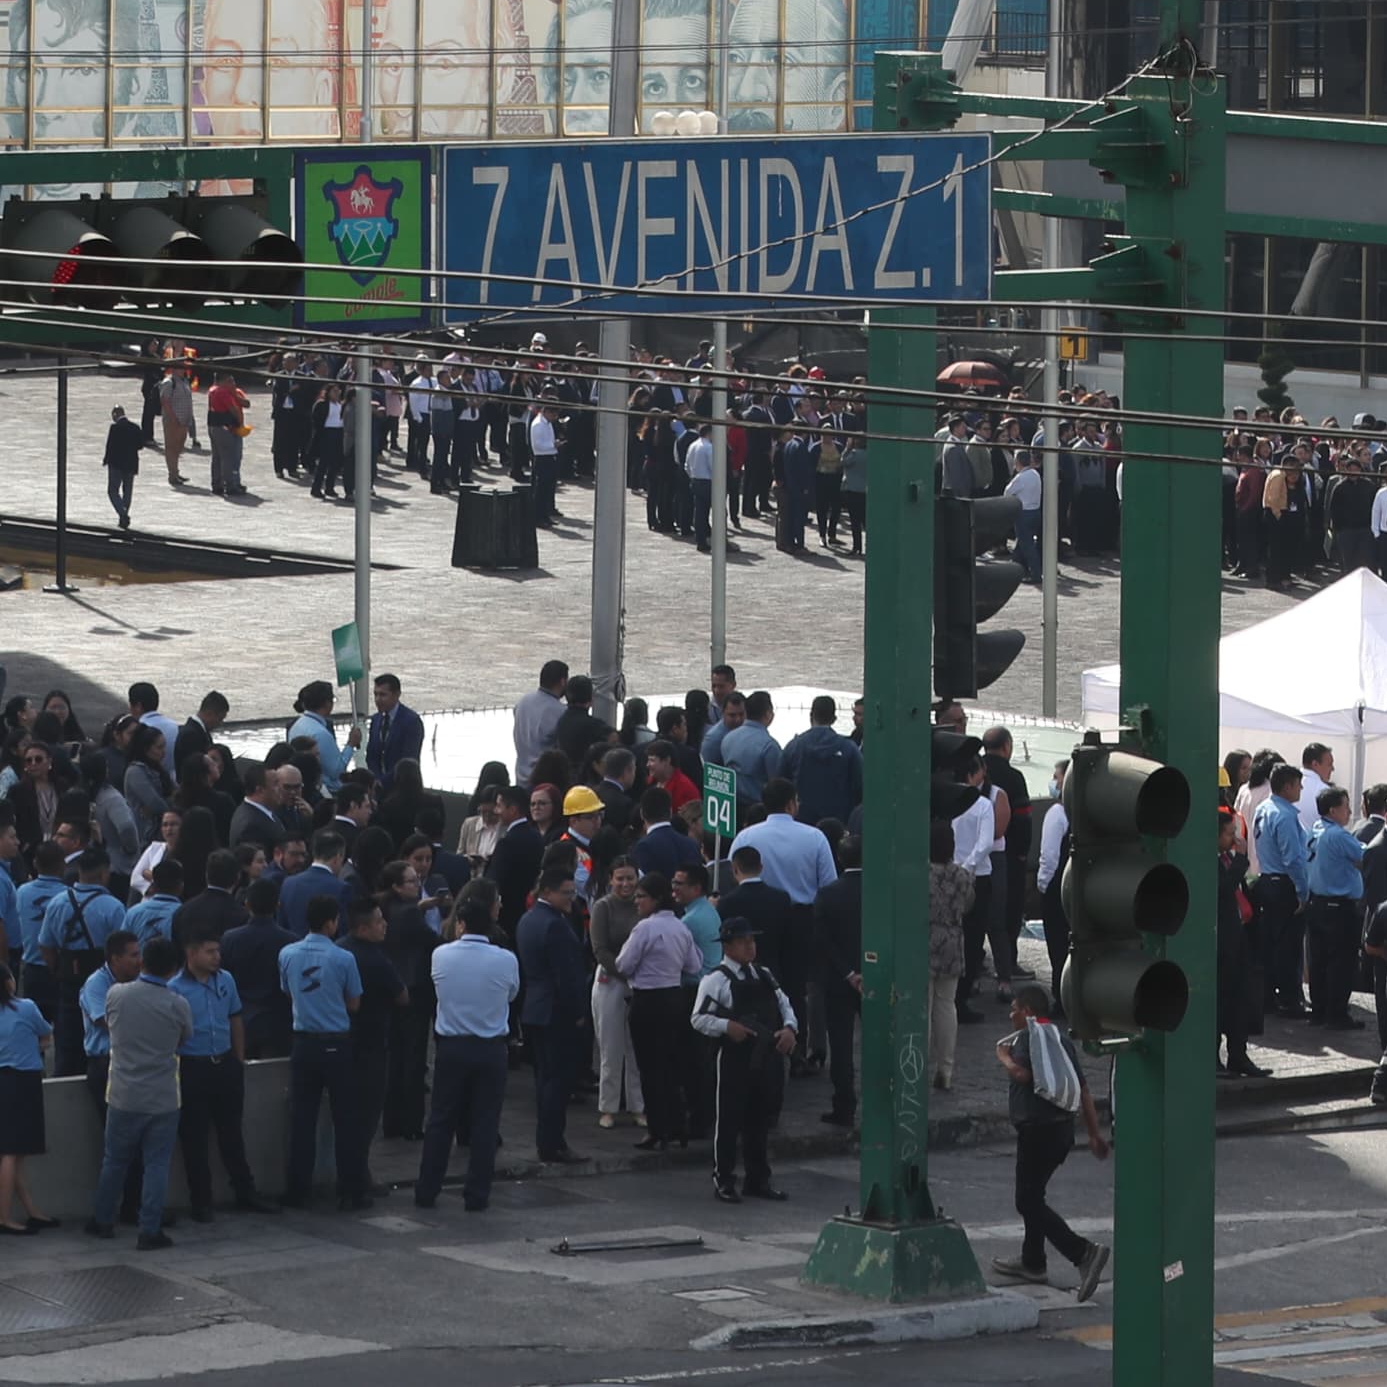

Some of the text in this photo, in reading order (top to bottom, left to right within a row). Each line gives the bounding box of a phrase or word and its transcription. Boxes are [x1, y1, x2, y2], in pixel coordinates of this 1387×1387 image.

[472, 166, 509, 303] 7
[532, 157, 855, 301] AVENIDA
[1067, 333, 1080, 356] 1
[707, 795, 731, 832] 04
